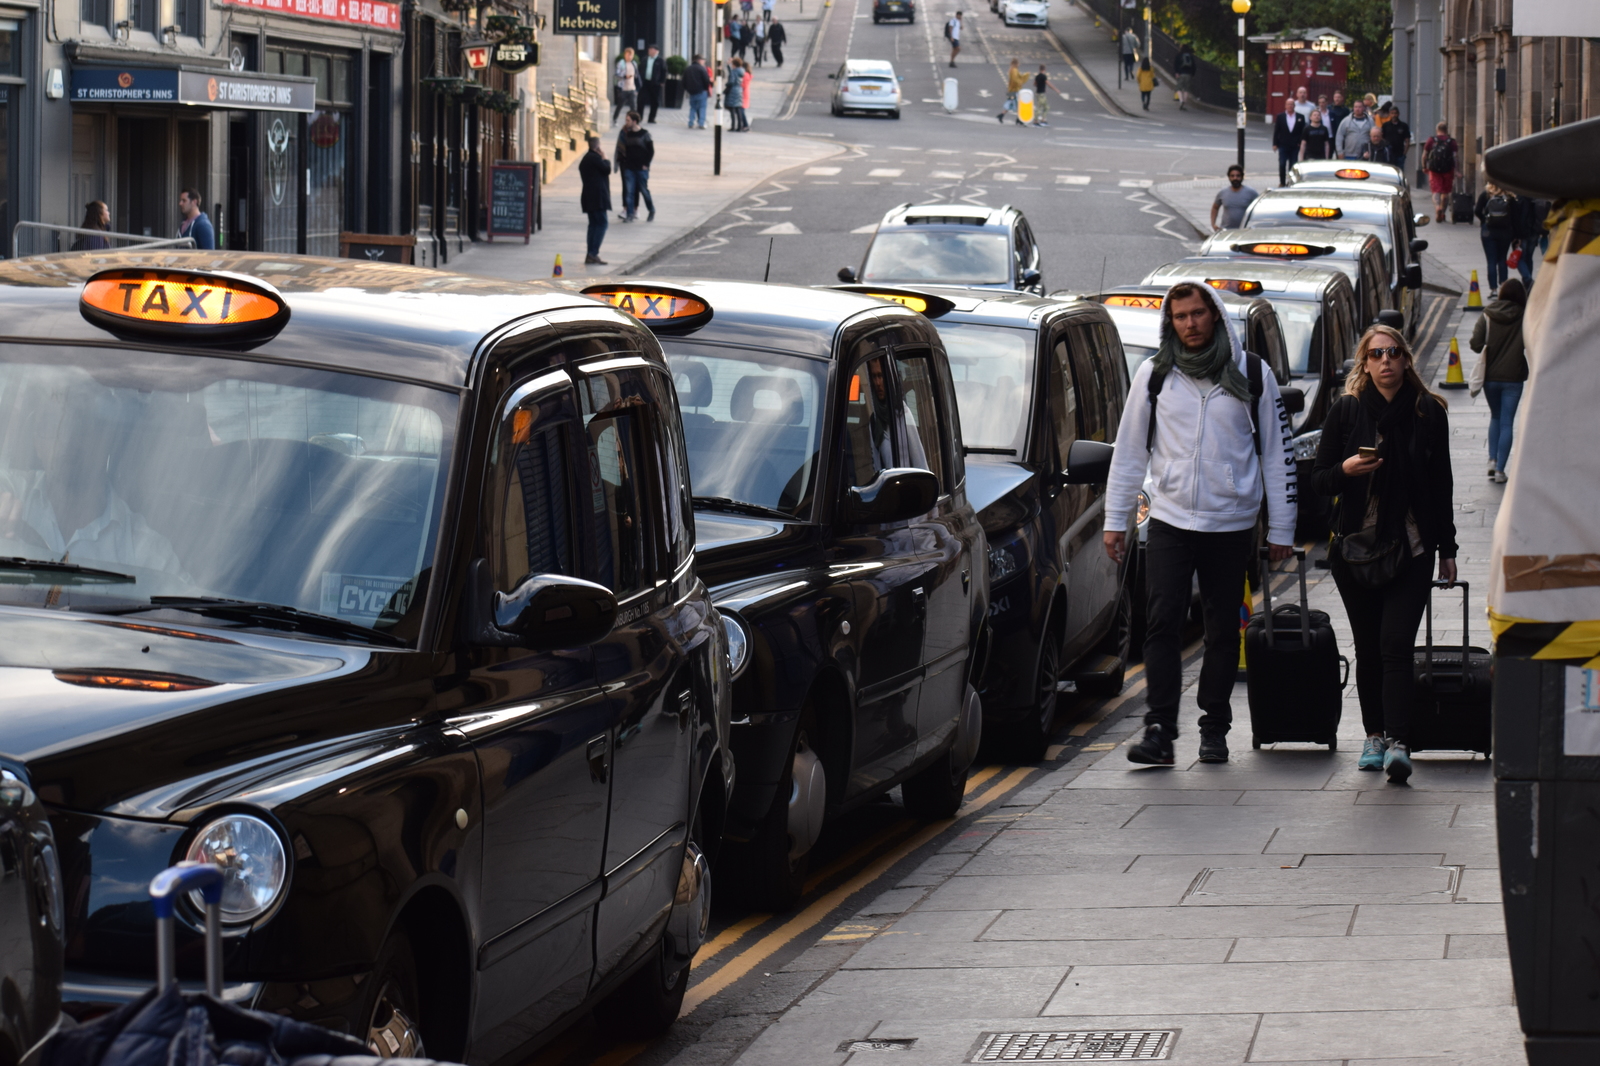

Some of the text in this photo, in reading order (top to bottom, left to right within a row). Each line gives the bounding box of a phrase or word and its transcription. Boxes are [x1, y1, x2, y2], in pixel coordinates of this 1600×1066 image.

[577, 1, 601, 13] The
[560, 16, 617, 30] Hebrides
[469, 49, 485, 66] T
[497, 51, 528, 61] BEST
[77, 88, 173, 99] ST CHRISTOPHER'S INNS
[219, 82, 292, 104] ST CHRISTOPHER'S INNS
[1265, 246, 1297, 254] TAXI
[119, 283, 232, 319] TAXI
[1275, 397, 1298, 504] HOLLISTER
